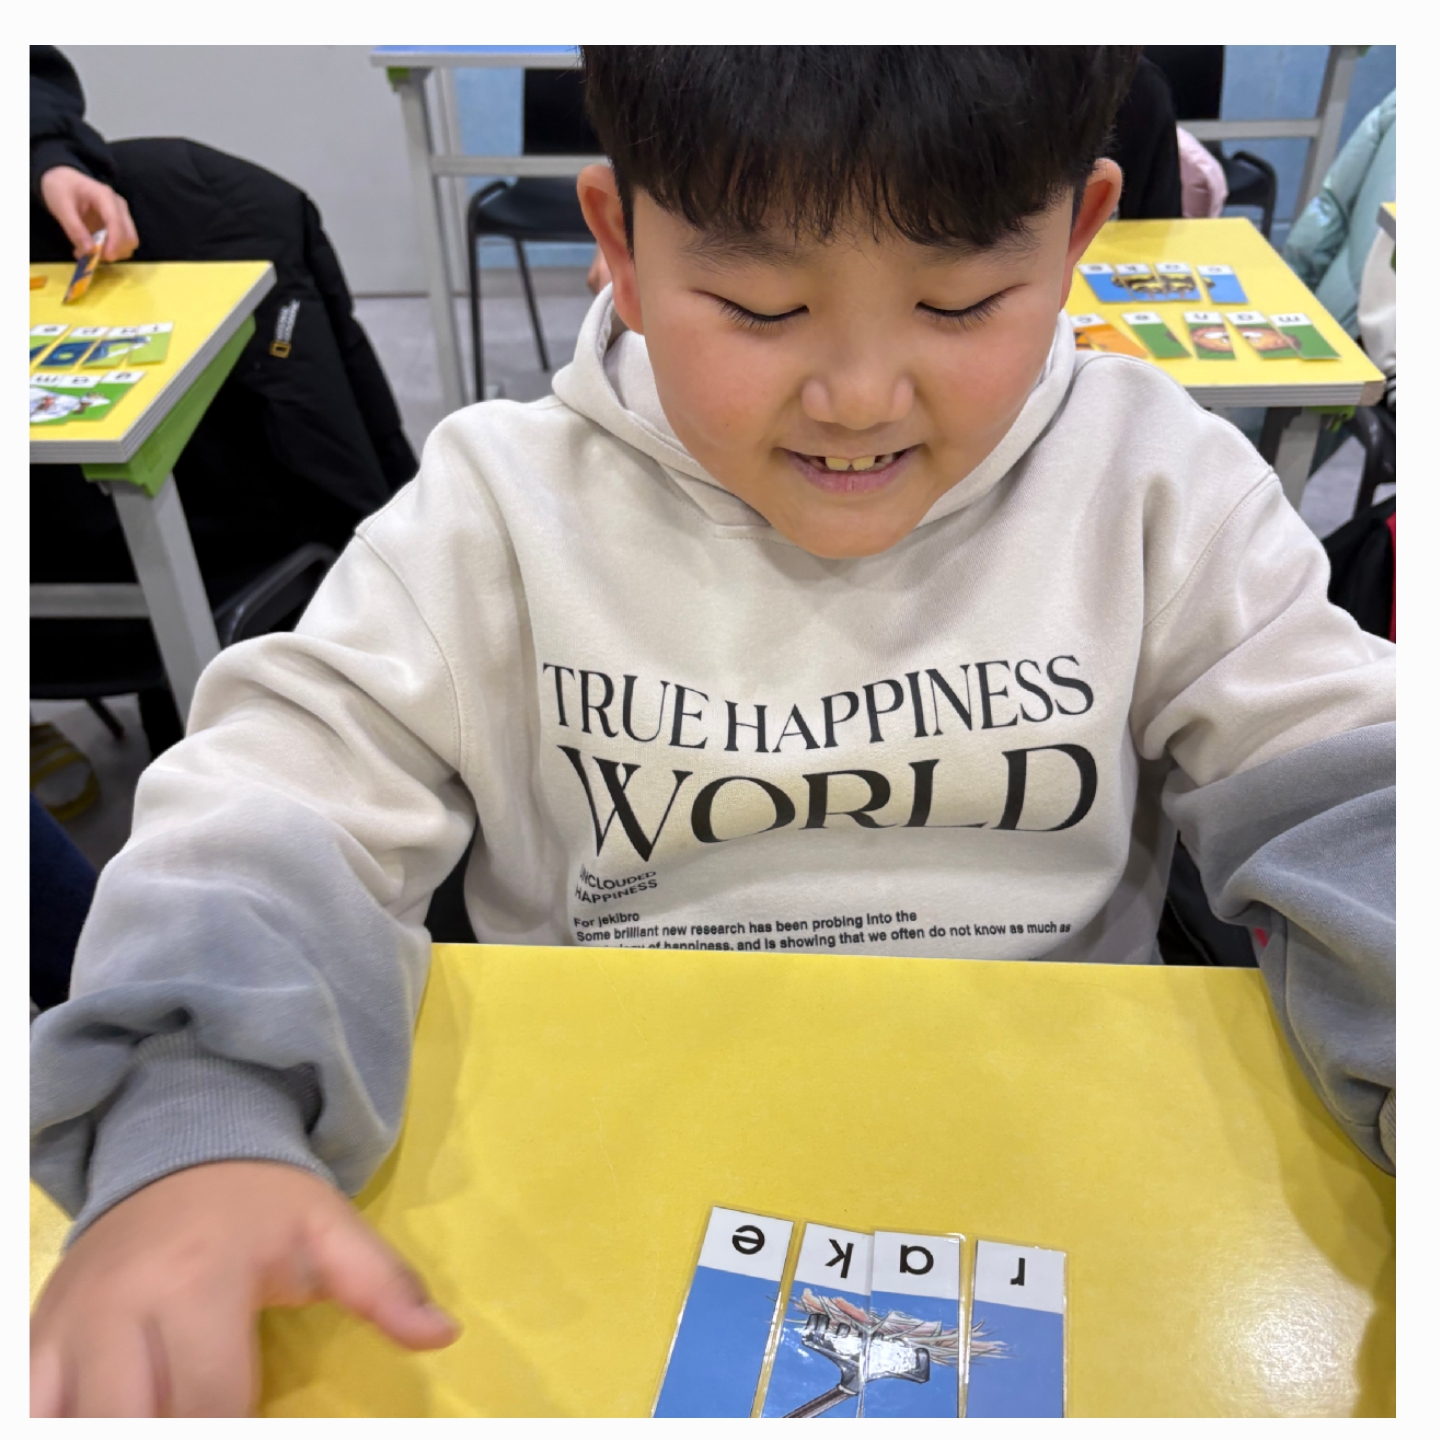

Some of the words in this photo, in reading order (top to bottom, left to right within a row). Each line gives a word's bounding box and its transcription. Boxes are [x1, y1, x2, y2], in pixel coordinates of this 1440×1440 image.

[543, 662, 709, 749] TRUE
[724, 654, 1095, 753] HAPPINESS
[557, 743, 1097, 862] WORLD
[575, 879, 657, 903] HAPPINESS
[573, 917, 594, 928] For
[577, 931, 611, 942] Some
[614, 925, 658, 939] brilliant
[662, 925, 687, 937] new
[691, 922, 745, 936] research
[749, 921, 772, 934] has
[776, 920, 808, 932] been
[812, 915, 863, 932] probing
[866, 912, 892, 925] into
[895, 910, 917, 923] the
[737, 938, 761, 951] and
[765, 937, 776, 949] is
[780, 934, 836, 948] showing
[839, 931, 865, 945] that
[869, 931, 887, 942] we
[891, 926, 925, 941] often
[929, 924, 946, 938] do
[950, 923, 972, 936] not
[974, 923, 1006, 936] know
[1009, 924, 1024, 935] as
[1027, 921, 1057, 934] much
[1060, 922, 1071, 933] as
